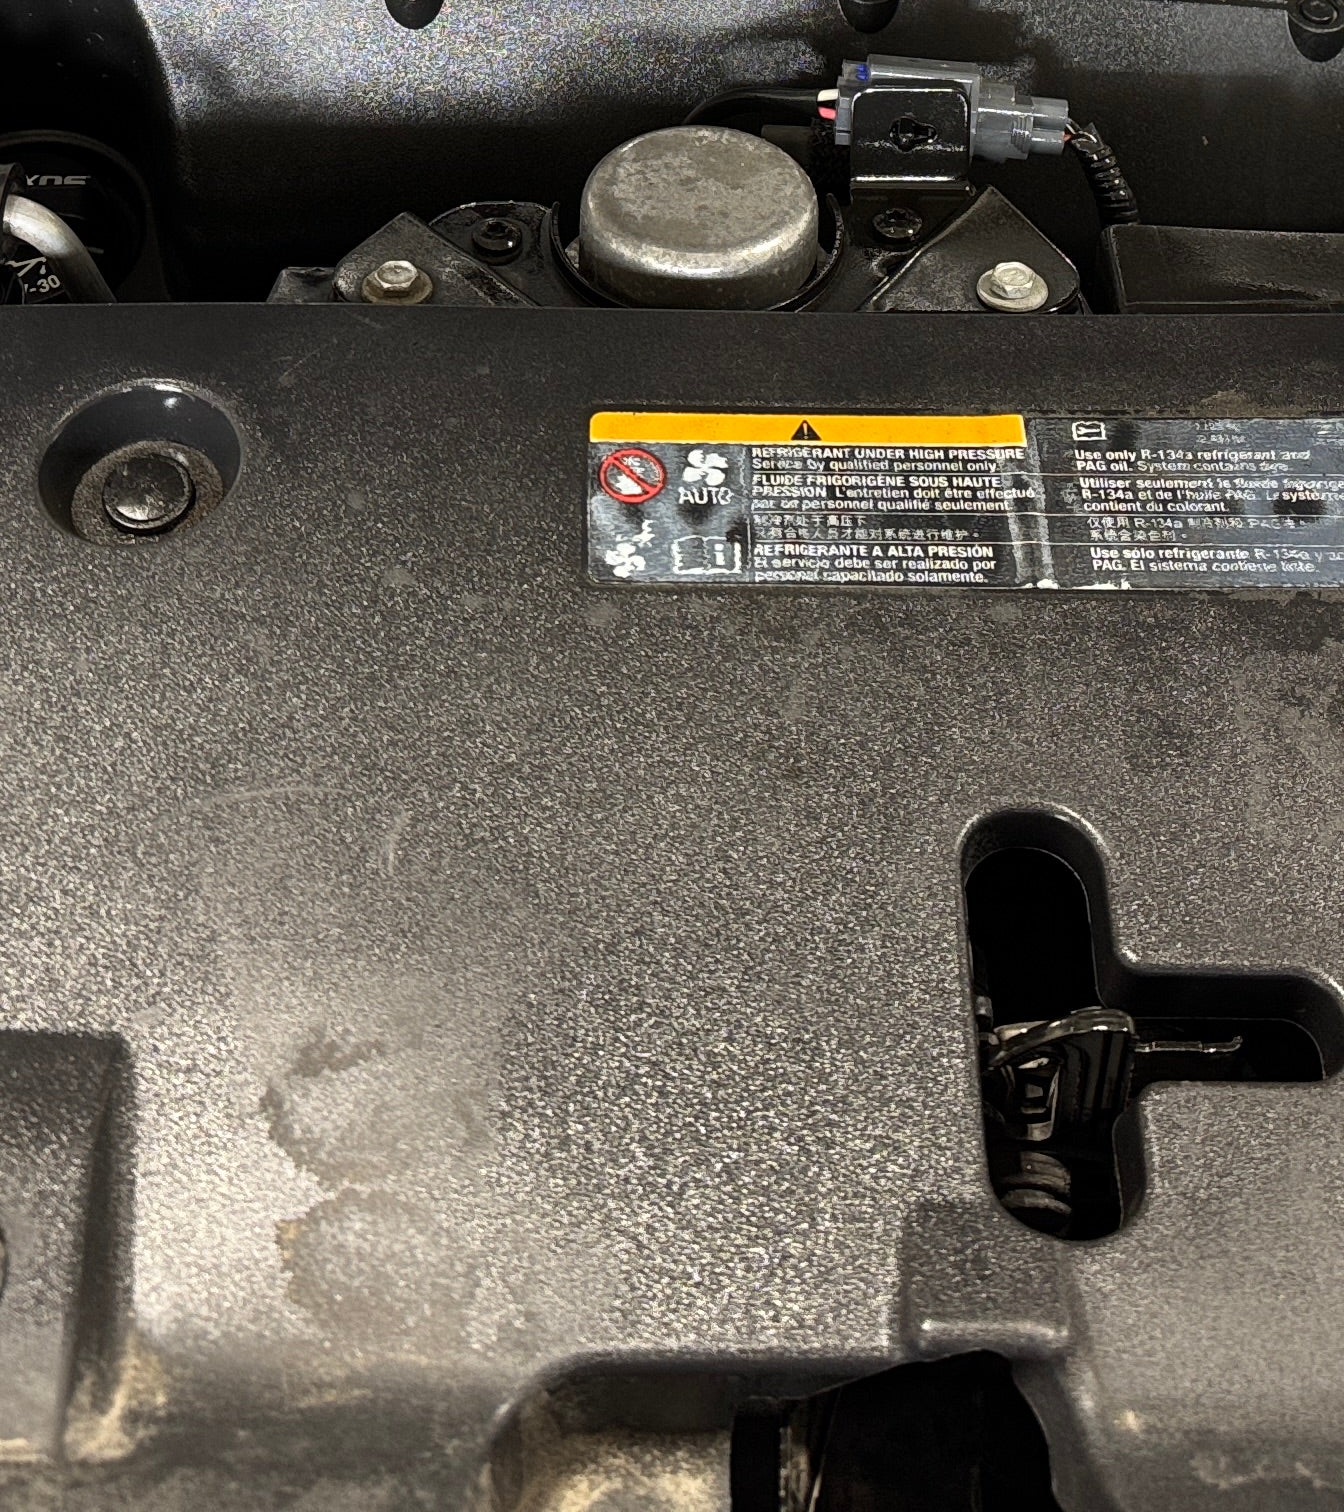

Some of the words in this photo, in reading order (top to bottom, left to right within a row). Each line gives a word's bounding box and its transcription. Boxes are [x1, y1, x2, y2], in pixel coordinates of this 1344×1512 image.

[24, 274, 61, 294] -30
[752, 447, 851, 459] REFRIGERANT
[854, 448, 905, 459] UNDER
[909, 449, 945, 460] HIGH
[948, 449, 1025, 460] PRESSURE
[1074, 449, 1102, 461] Use
[1105, 449, 1137, 462] only
[1140, 449, 1193, 461] R-134a
[829, 458, 889, 472] qualified
[893, 460, 963, 472] personnel
[1076, 460, 1107, 471] PAG
[1110, 461, 1134, 472] oil.
[1137, 461, 1191, 473] System
[752, 474, 804, 486] FLUIDE
[909, 476, 949, 487] SOUS
[952, 476, 1002, 487] HAUTE
[1079, 477, 1132, 489] Utiliser
[1135, 477, 1214, 489] seulement
[679, 487, 733, 505] AUTO
[836, 487, 910, 499] L'entretien
[913, 488, 940, 499] doit
[944, 488, 973, 499] être
[976, 487, 1036, 499] effectué
[1082, 488, 1134, 500] R-134a
[1138, 489, 1154, 500] et
[1156, 489, 1173, 500] de
[801, 499, 874, 511] personnel
[877, 498, 931, 512] qualifié
[1083, 501, 1143, 512] contient
[1146, 501, 1163, 512] du
[754, 543, 869, 557] REFRIGERANTE
[872, 545, 884, 557] A
[887, 546, 925, 557] ALTA
[928, 543, 994, 558] PRESIÓN
[1090, 547, 1119, 559] Use
[1123, 547, 1155, 559] sólo
[1158, 548, 1250, 562] refrigerante
[834, 557, 871, 569] debe
[874, 559, 899, 569] ser
[902, 558, 969, 570] realizado
[972, 560, 997, 572] por
[1092, 559, 1127, 571] PAG.
[1130, 560, 1145, 571] El
[1149, 560, 1208, 572] sistema
[822, 569, 904, 583] capacitado
[907, 570, 989, 584] solamente.
